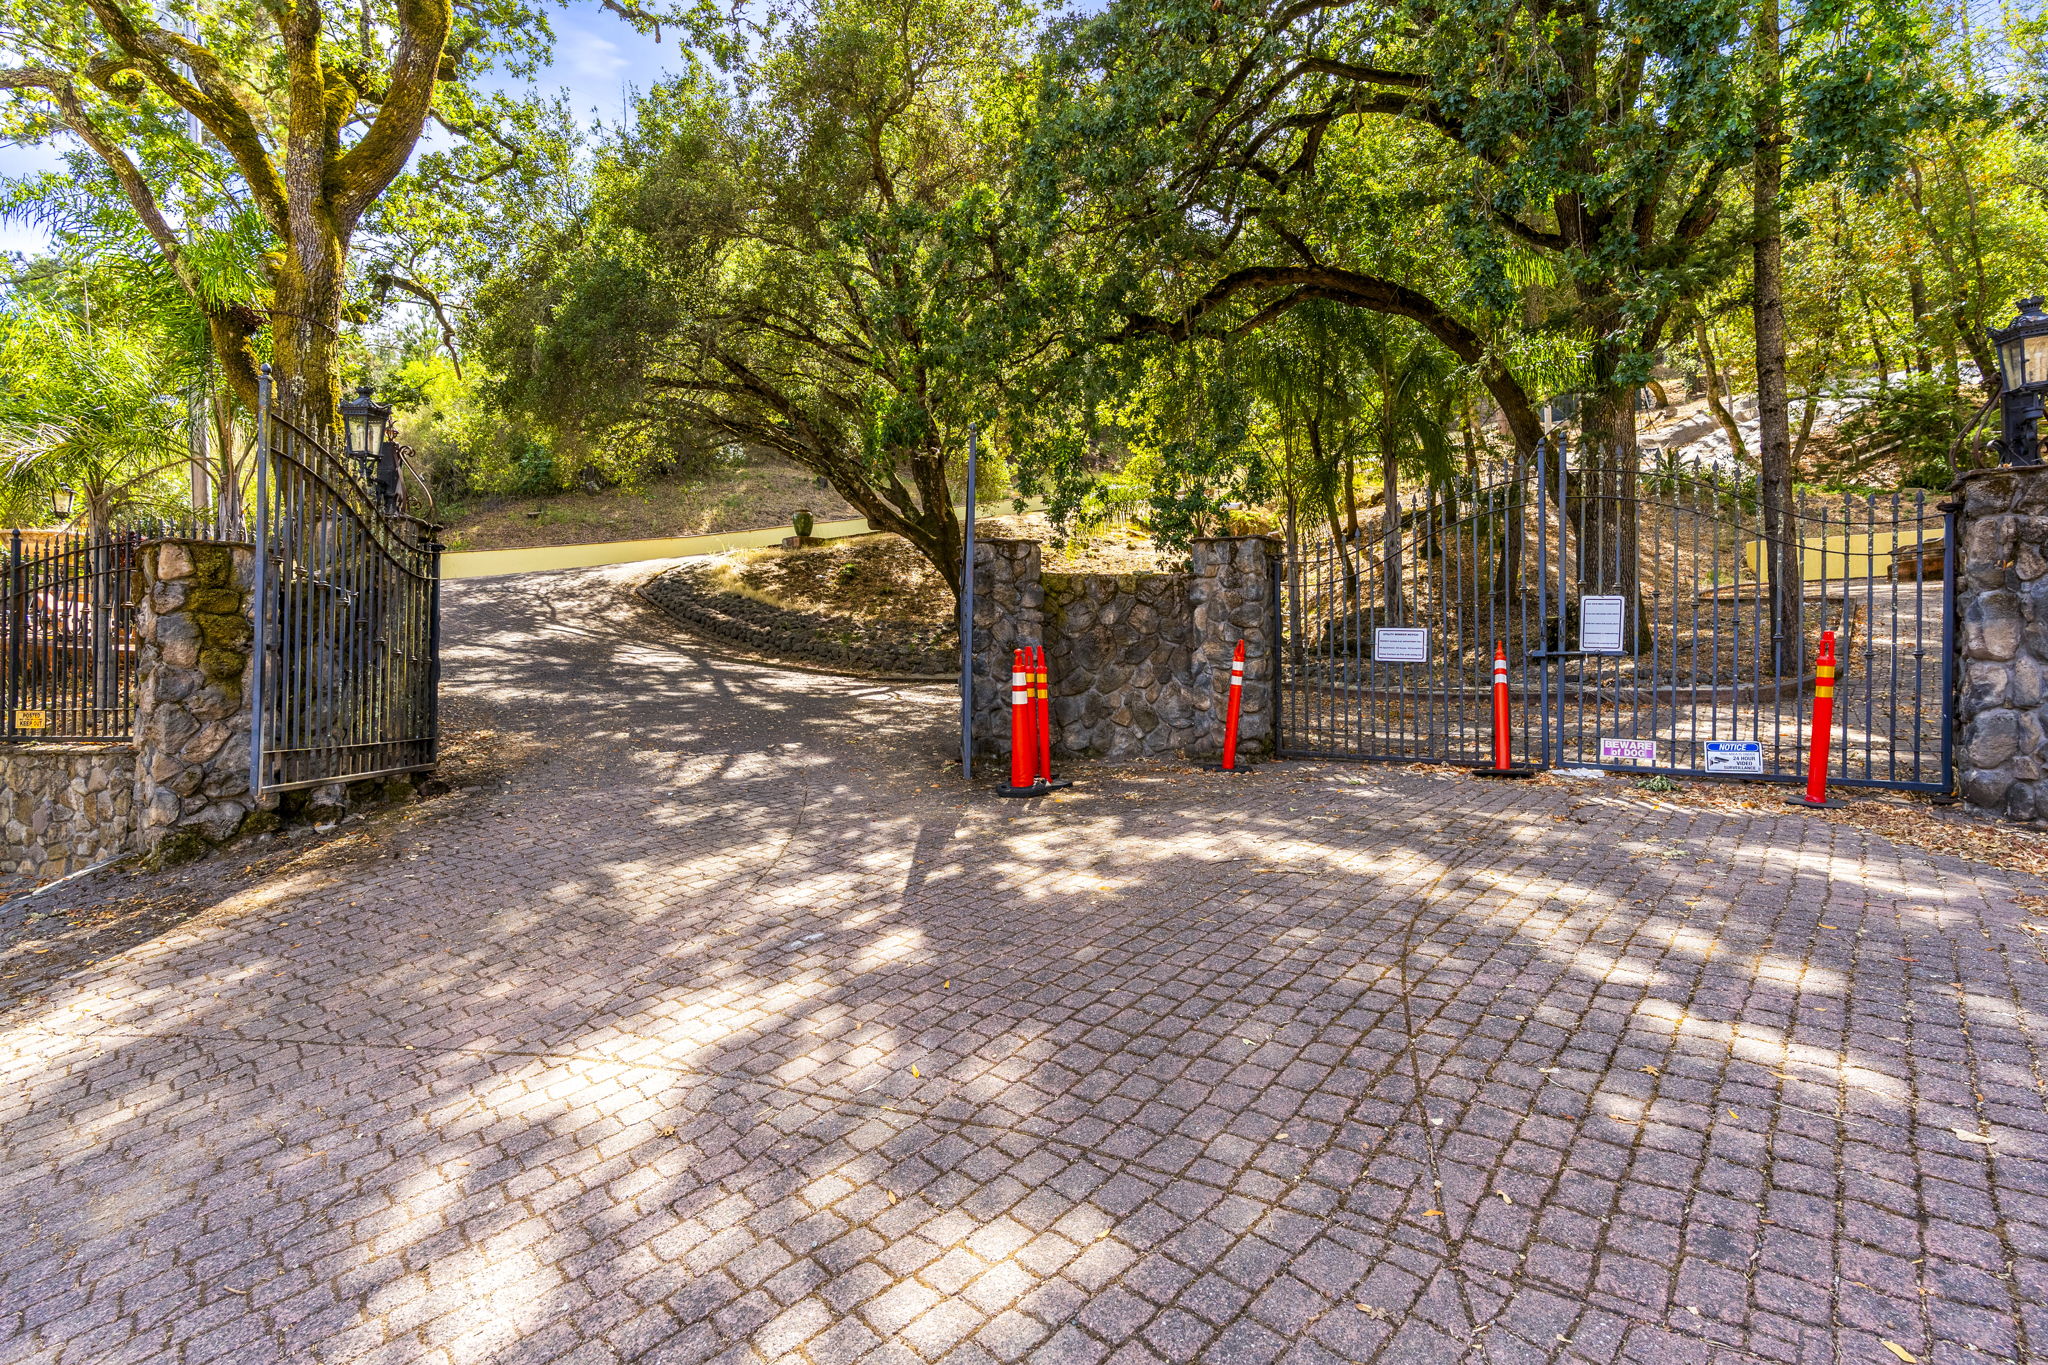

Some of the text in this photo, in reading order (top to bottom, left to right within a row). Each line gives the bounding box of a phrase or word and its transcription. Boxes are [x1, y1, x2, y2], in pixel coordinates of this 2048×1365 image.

[1604, 740, 1653, 750] BEWARE
[1719, 743, 1747, 751] NOTICE
[1624, 749, 1646, 757] DOG
